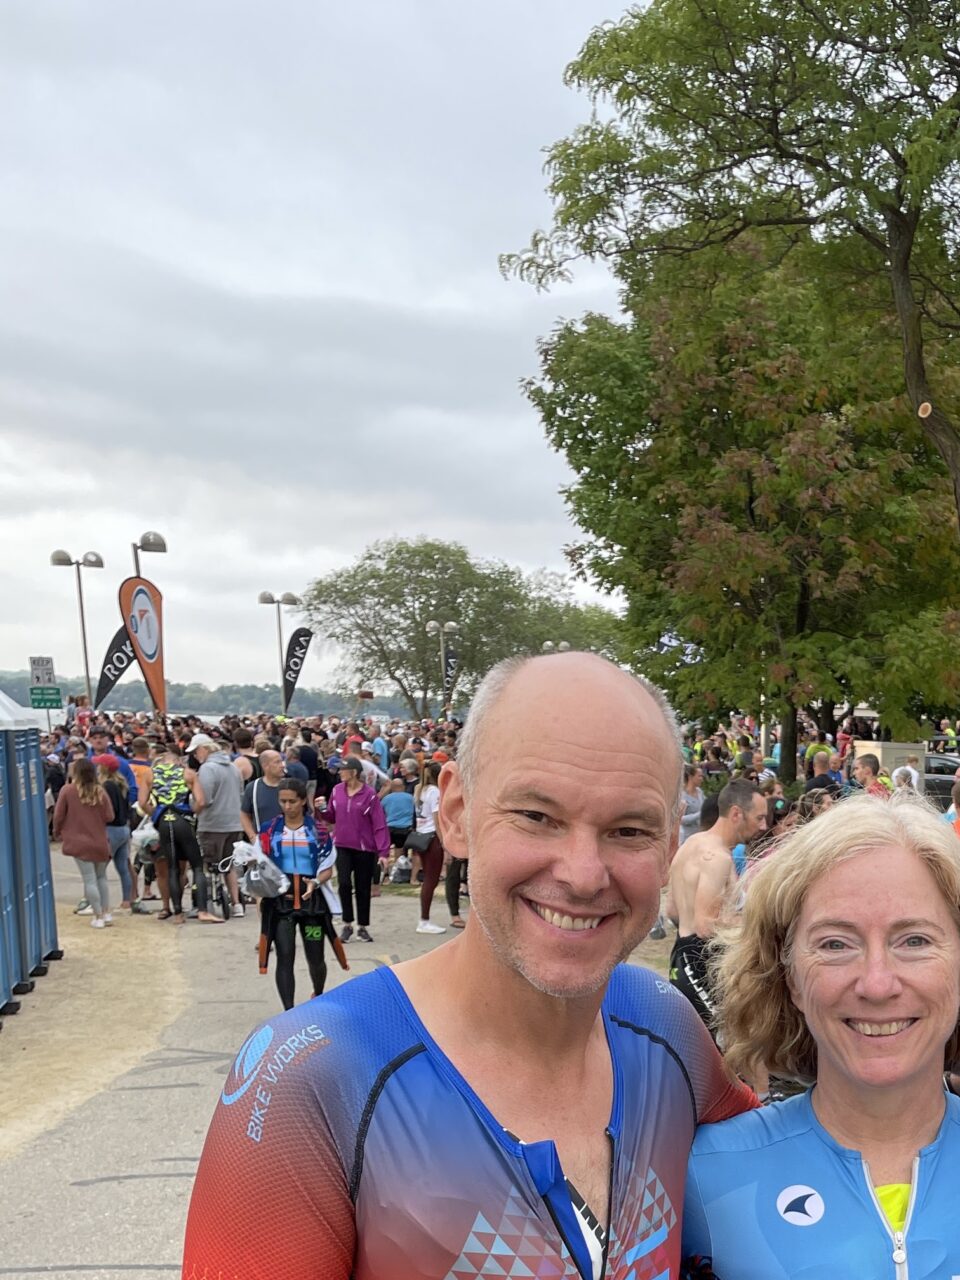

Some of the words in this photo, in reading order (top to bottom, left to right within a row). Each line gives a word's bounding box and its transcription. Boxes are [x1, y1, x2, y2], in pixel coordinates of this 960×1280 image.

[103, 640, 136, 680] ROK
[285, 637, 310, 682] ROKA
[246, 1084, 272, 1142] BIKE
[261, 1024, 326, 1084] WORKS
